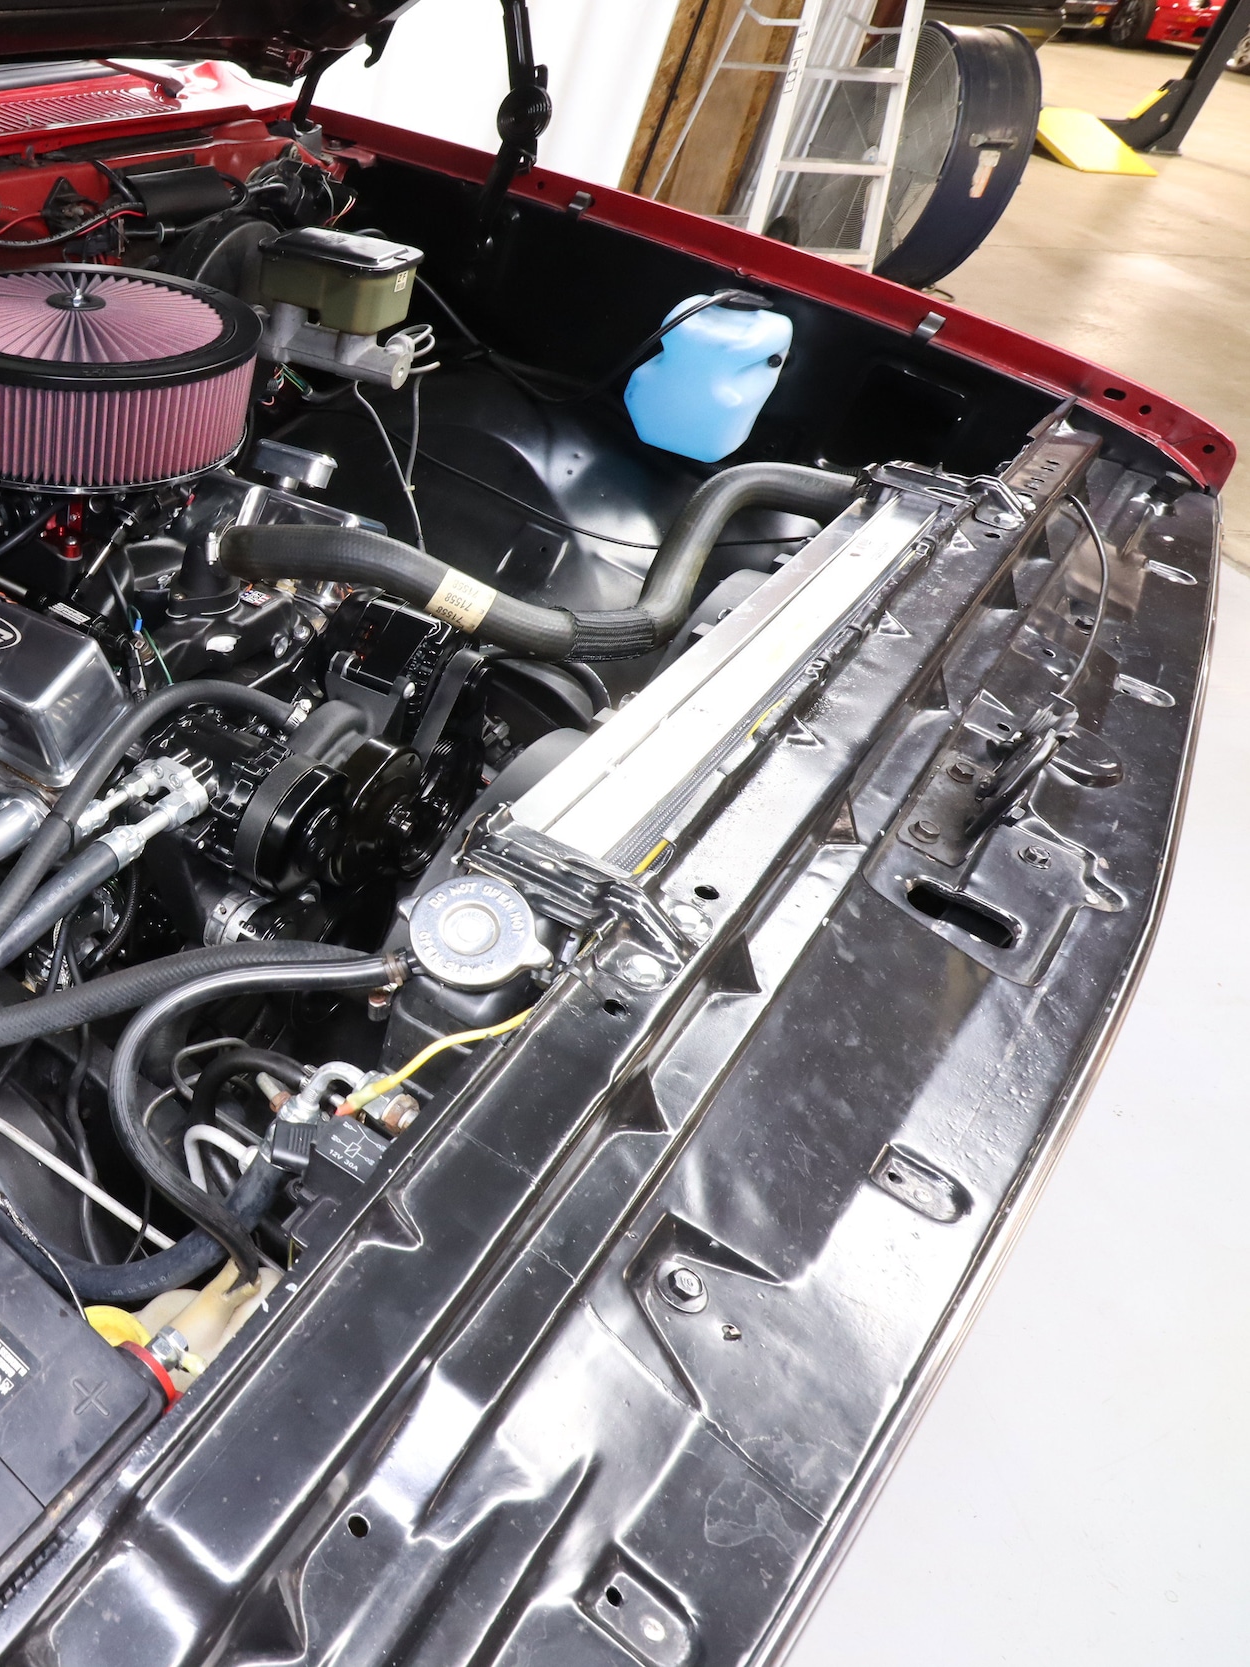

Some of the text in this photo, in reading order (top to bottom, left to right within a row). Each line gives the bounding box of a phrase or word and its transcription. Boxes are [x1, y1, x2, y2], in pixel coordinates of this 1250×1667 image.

[444, 592, 472, 612] 71558
[436, 606, 463, 624] 71558
[428, 883, 525, 935] DO NOT OPEN HOT
[329, 1149, 344, 1160] 12V
[343, 1159, 358, 1172] 30A
